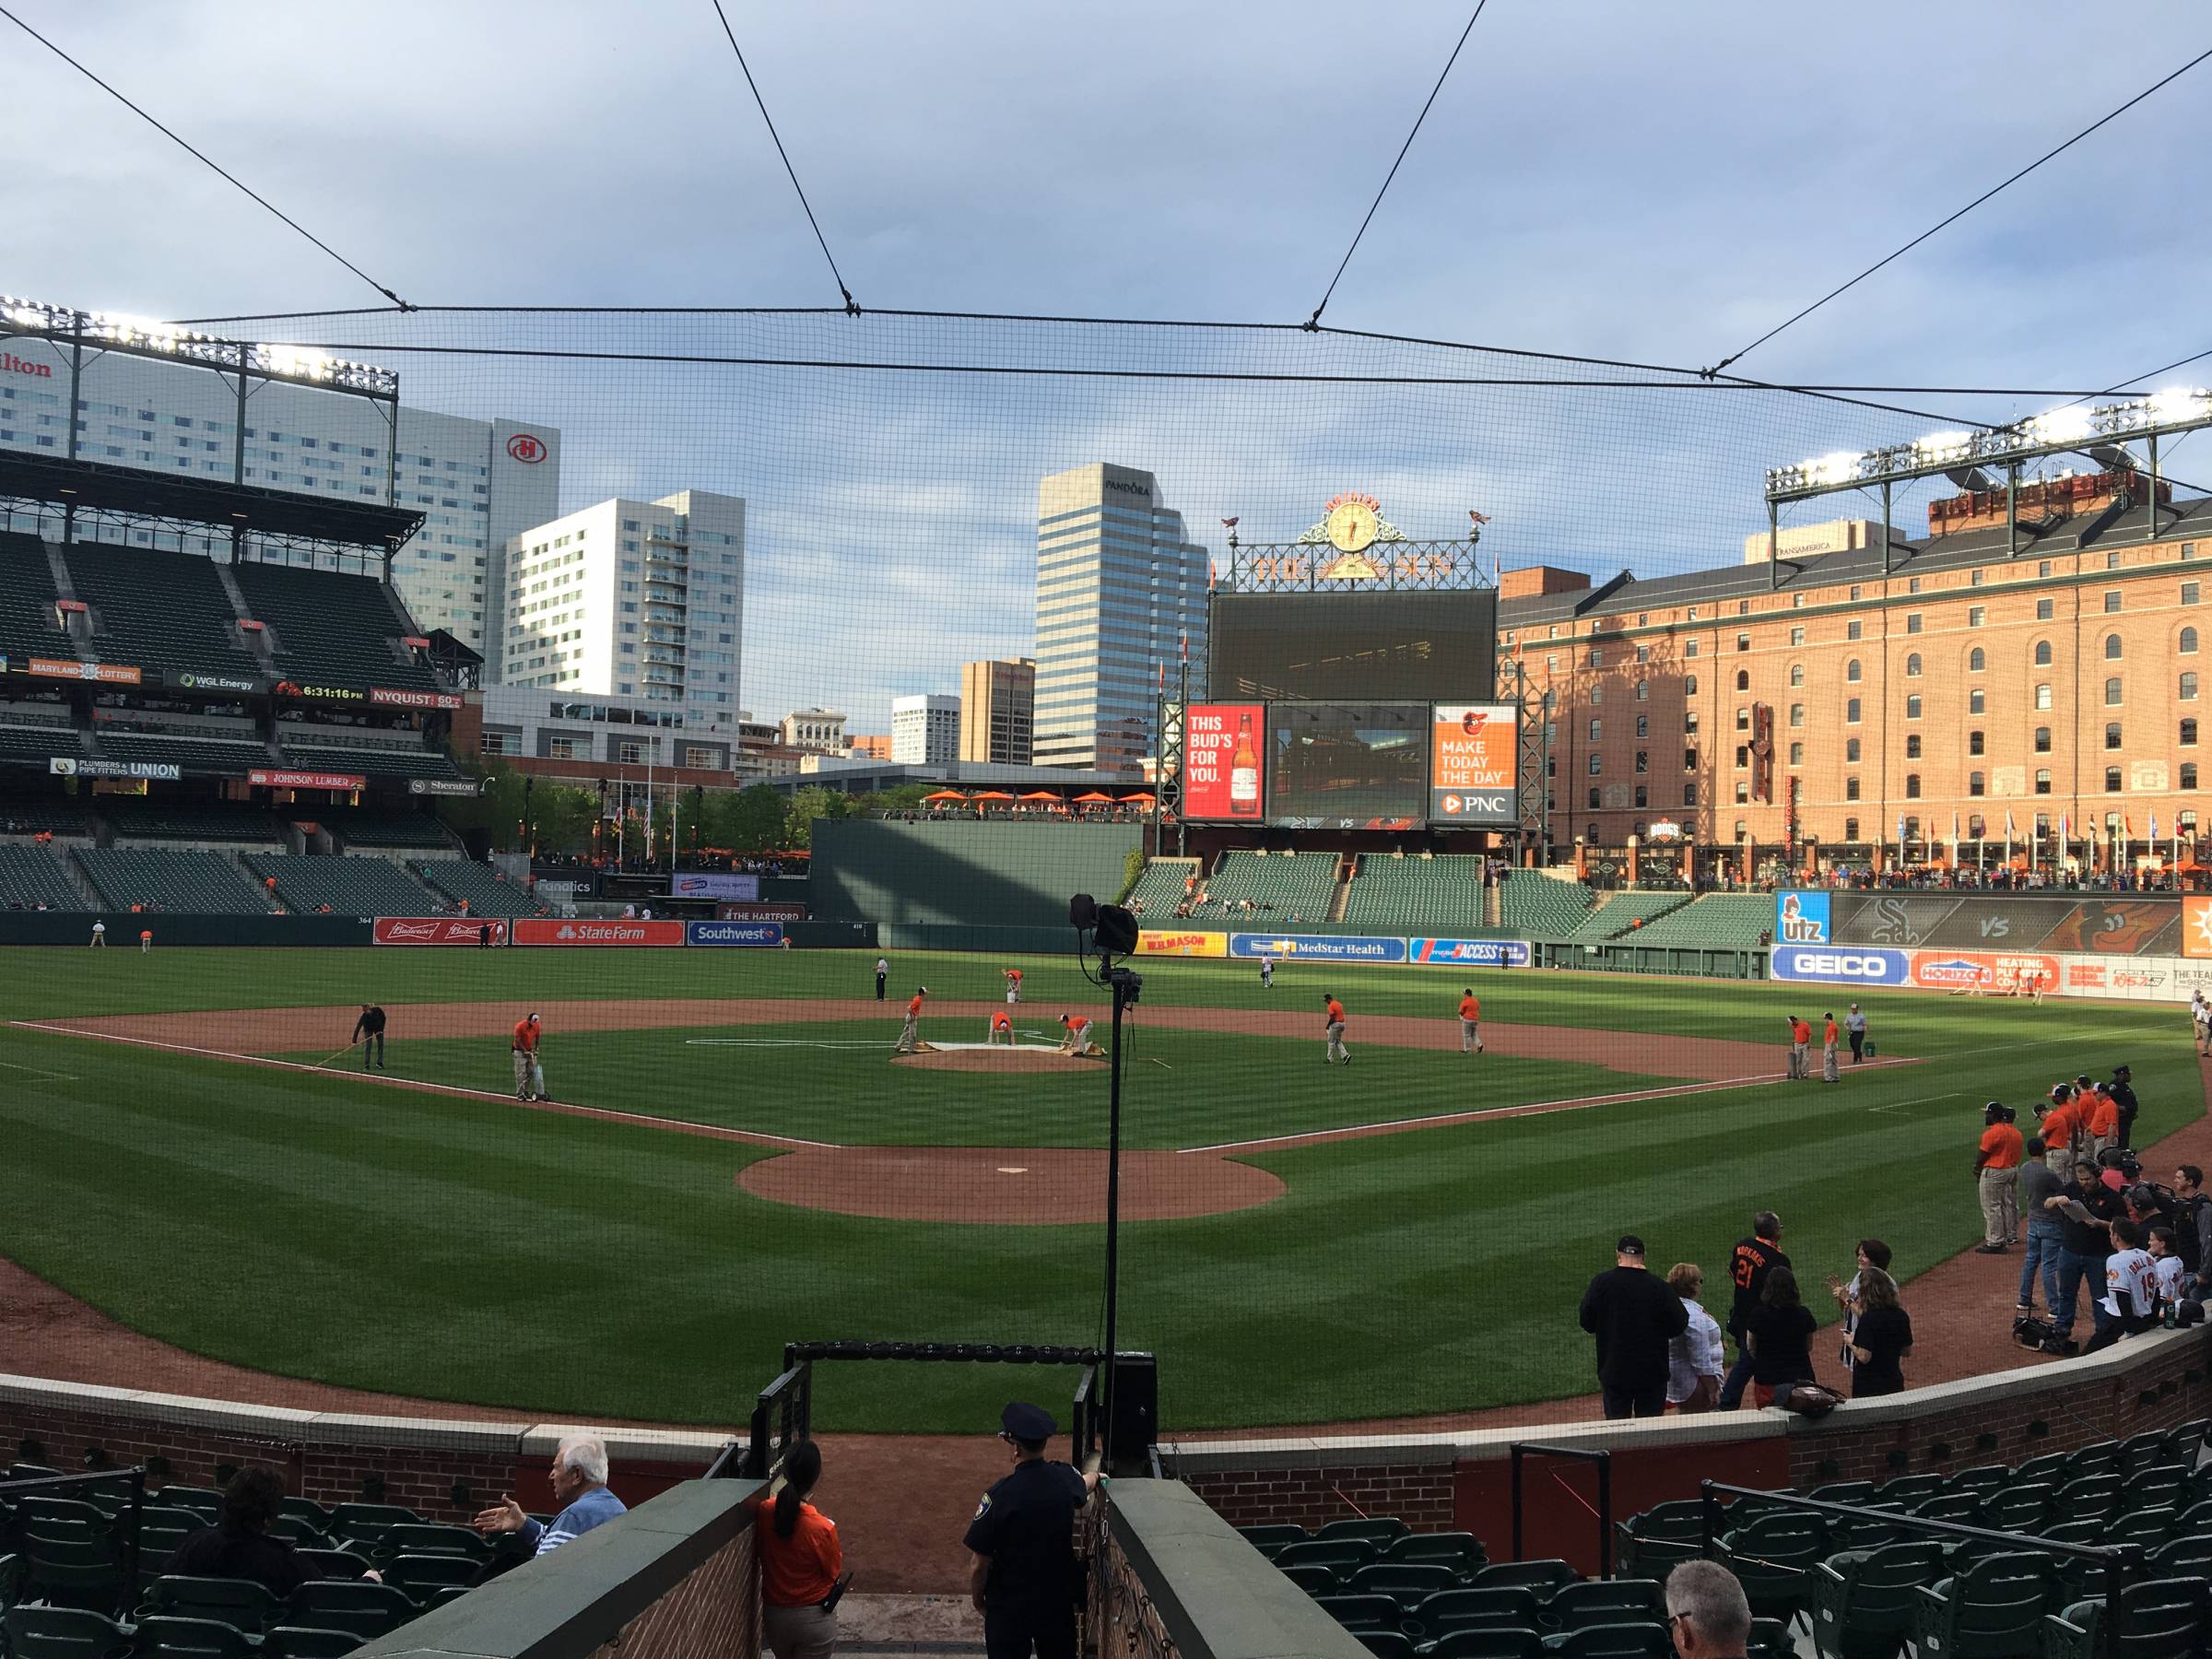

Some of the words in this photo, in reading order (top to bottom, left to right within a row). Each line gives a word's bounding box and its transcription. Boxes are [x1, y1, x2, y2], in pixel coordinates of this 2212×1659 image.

[1105, 480, 1150, 497] PANDORA
[1253, 557, 1309, 581] THE
[1395, 555, 1453, 578] SUN
[32, 663, 79, 676] MARYLAND
[100, 672, 136, 680] LOTTERY
[196, 676, 218, 687] WGL
[219, 677, 253, 690] Energy
[303, 686, 349, 699] 6:31:16
[373, 690, 431, 705] NYQUIST
[1190, 716, 1222, 730] THIS
[1190, 734, 1232, 747] BUD'S
[1441, 740, 1486, 754] MAKE
[79, 759, 117, 769] PLUMBERS
[1190, 750, 1217, 765] FOR
[1441, 756, 1488, 769] TODAY
[130, 762, 180, 777] UNION
[1190, 768, 1221, 782] YOU.
[273, 773, 313, 784] JOHNSON
[315, 776, 349, 786] LUMBER
[1441, 771, 1471, 783] THE
[1474, 771, 1502, 783] DAY
[430, 780, 474, 791] Sheraton
[1464, 796, 1506, 812] PNC
[539, 878, 591, 892] Fanatics
[734, 912, 750, 921] THE
[752, 912, 799, 922] HARTFORD
[394, 924, 434, 935] Budweiser
[698, 926, 765, 940] Southwest
[1298, 943, 1343, 954] MedStar
[1346, 944, 1385, 955] Health
[1460, 944, 1499, 959] ACCESS
[1794, 954, 1887, 977] GEICO
[1996, 958, 2043, 969] HEATING
[2173, 970, 2191, 979] THE
[2193, 970, 2212, 980] TEA
[1735, 1259, 1754, 1289] 21
[2141, 1272, 2155, 1302] 19
